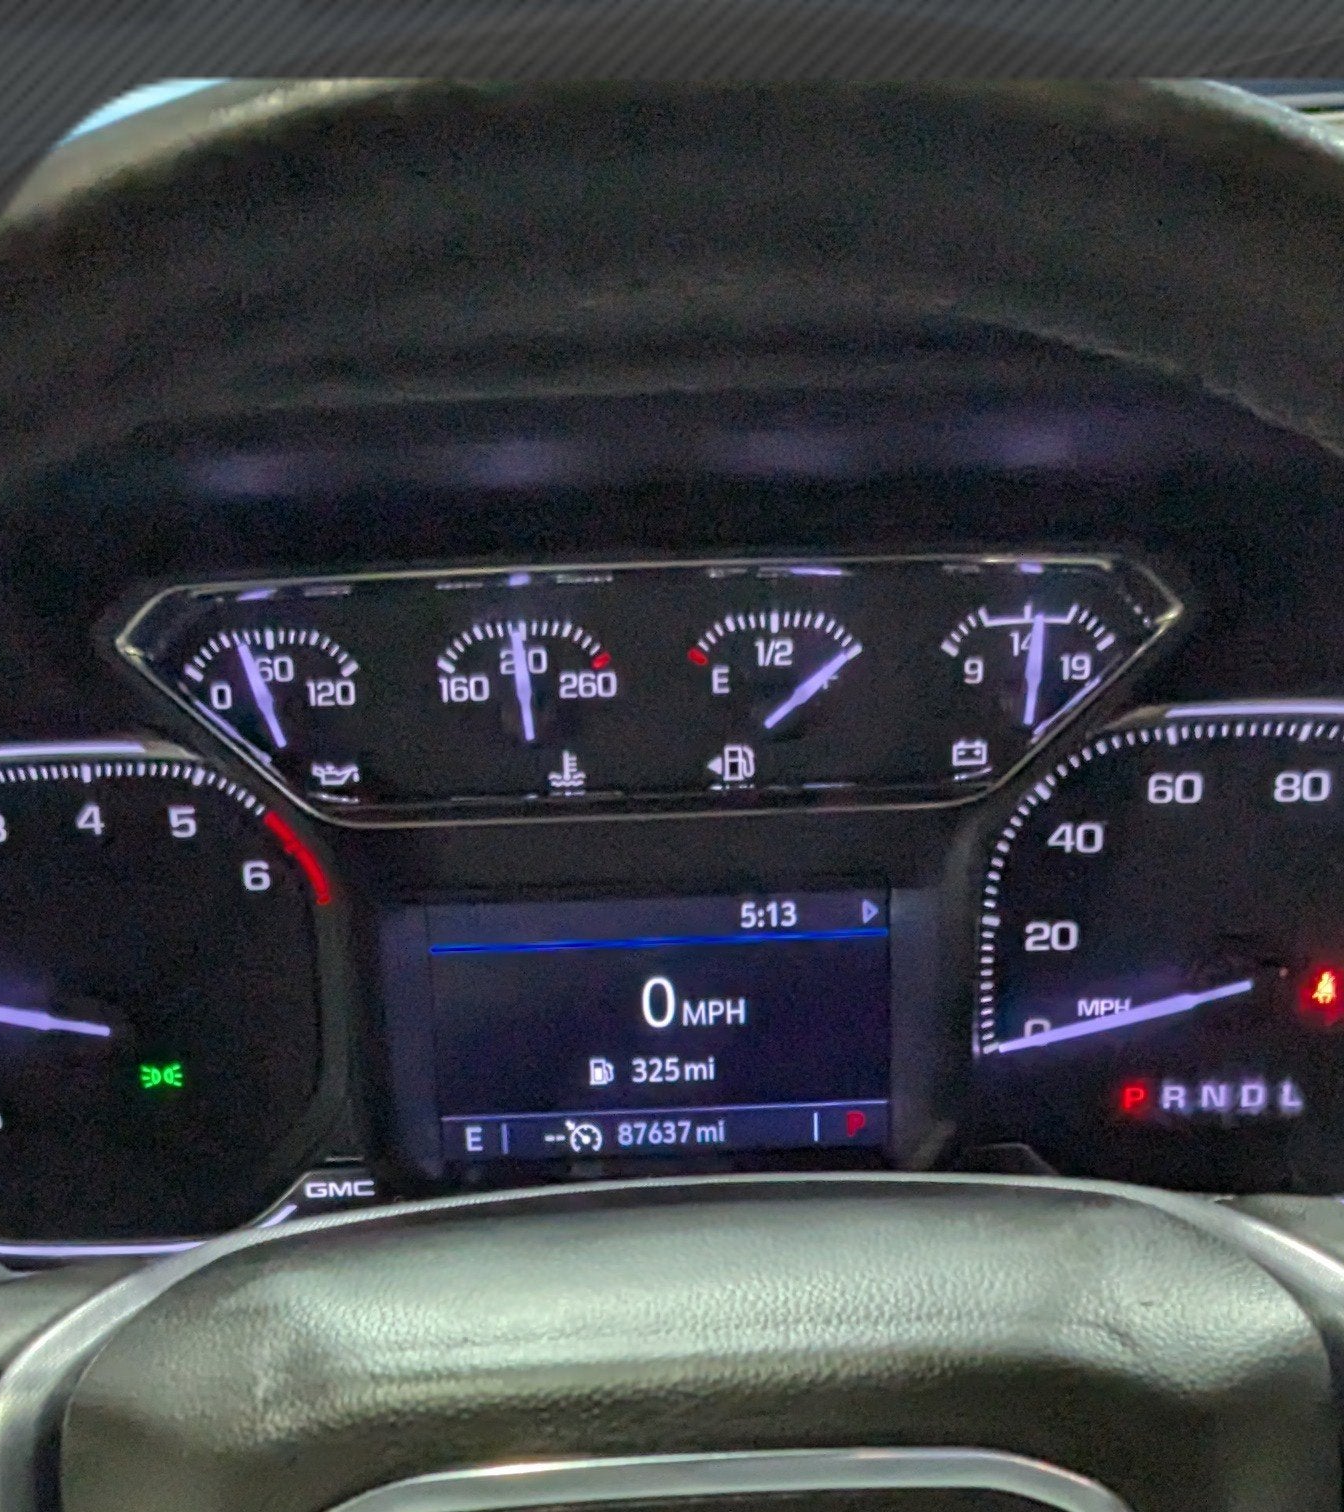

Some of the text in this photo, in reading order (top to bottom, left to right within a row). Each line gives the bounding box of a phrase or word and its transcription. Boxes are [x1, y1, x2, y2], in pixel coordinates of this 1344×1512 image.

[499, 648, 548, 676] 20
[755, 638, 793, 668] 1/2
[1060, 653, 1092, 682] 19
[255, 656, 295, 684] 60
[712, 666, 731, 695] E
[963, 658, 984, 685] 9
[210, 682, 233, 711] 0
[307, 680, 356, 708] 120
[439, 674, 490, 703] 160
[559, 671, 618, 700] 260
[1148, 772, 1203, 805] 60
[1274, 770, 1332, 803] 80
[75, 804, 105, 836] 4
[167, 806, 198, 839] 5
[1047, 823, 1105, 854] 40
[242, 860, 272, 892] 6
[739, 901, 798, 929] 5:13
[1024, 920, 1079, 952] 20
[641, 976, 747, 1028] 0 MPH
[1077, 998, 1131, 1017] MPH
[846, 1110, 866, 1137] P
[465, 1125, 484, 1152] E
[304, 1180, 376, 1199] GMC
